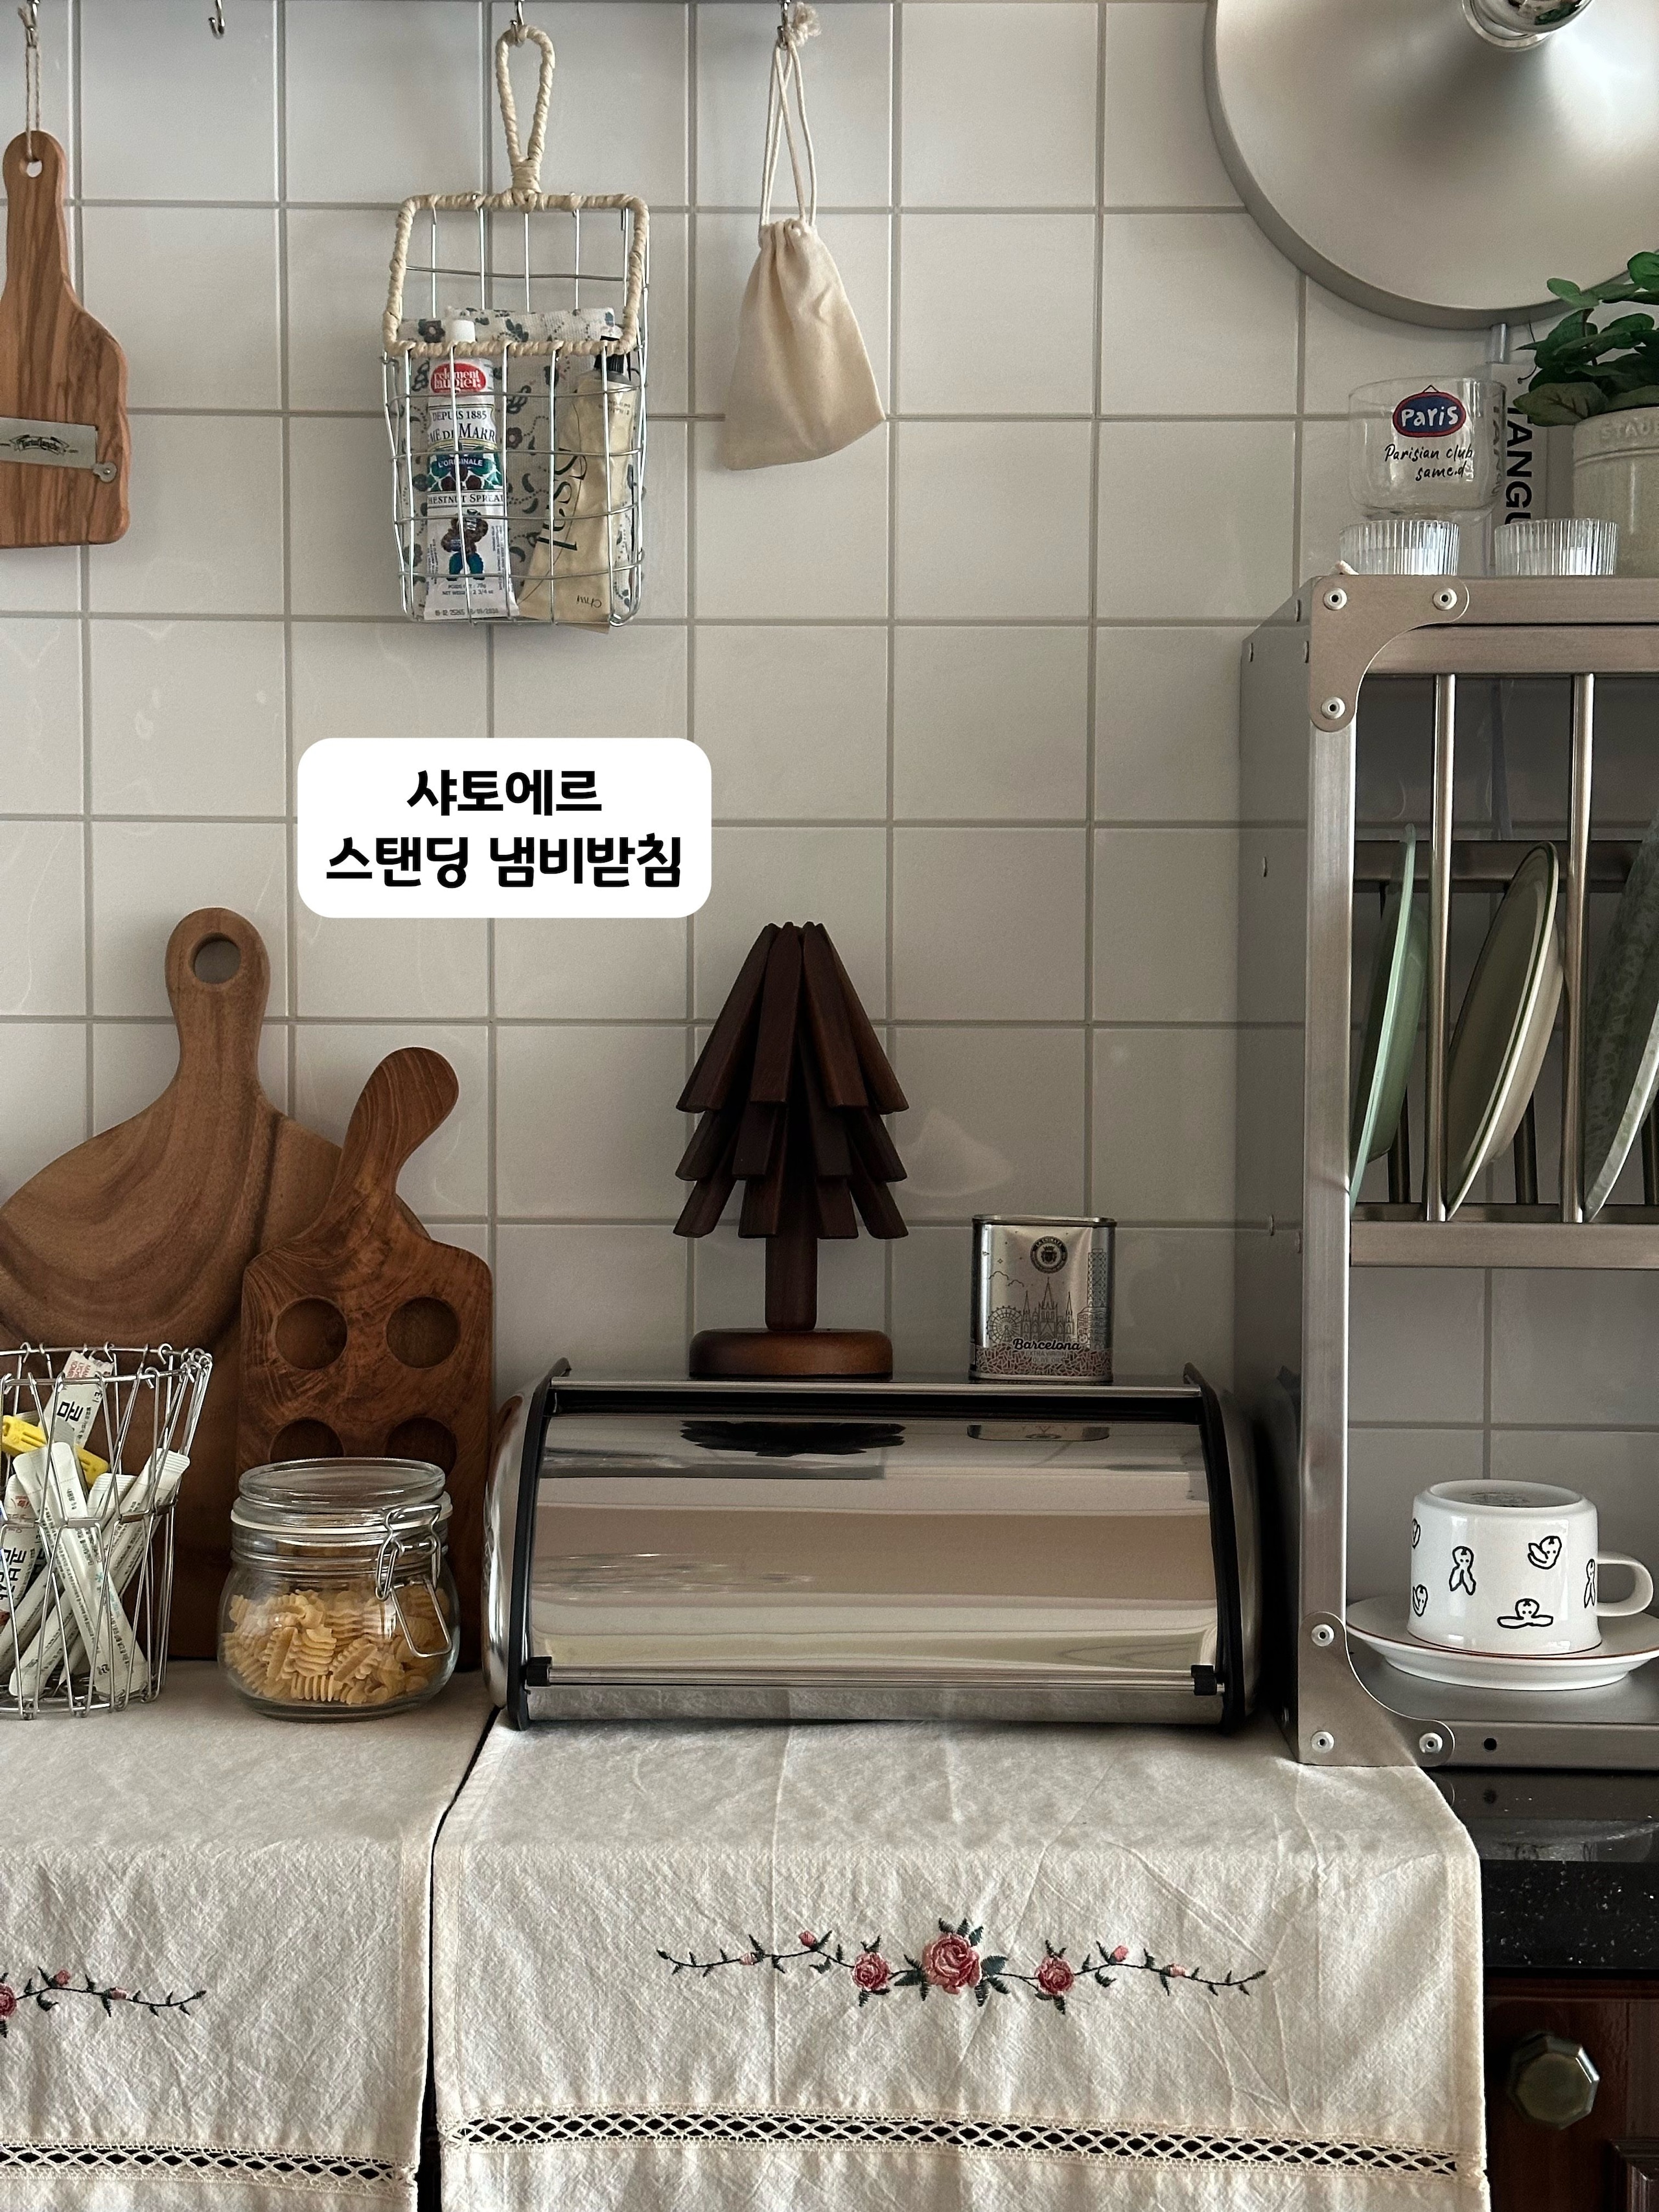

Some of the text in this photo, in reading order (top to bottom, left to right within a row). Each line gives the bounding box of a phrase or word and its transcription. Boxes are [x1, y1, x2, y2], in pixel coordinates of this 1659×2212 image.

[466, 410, 487, 420] 1885
[1401, 406, 1459, 427] Paris
[1385, 443, 1473, 462] Parisian club
[1012, 1338, 1082, 1351] Barcelona
